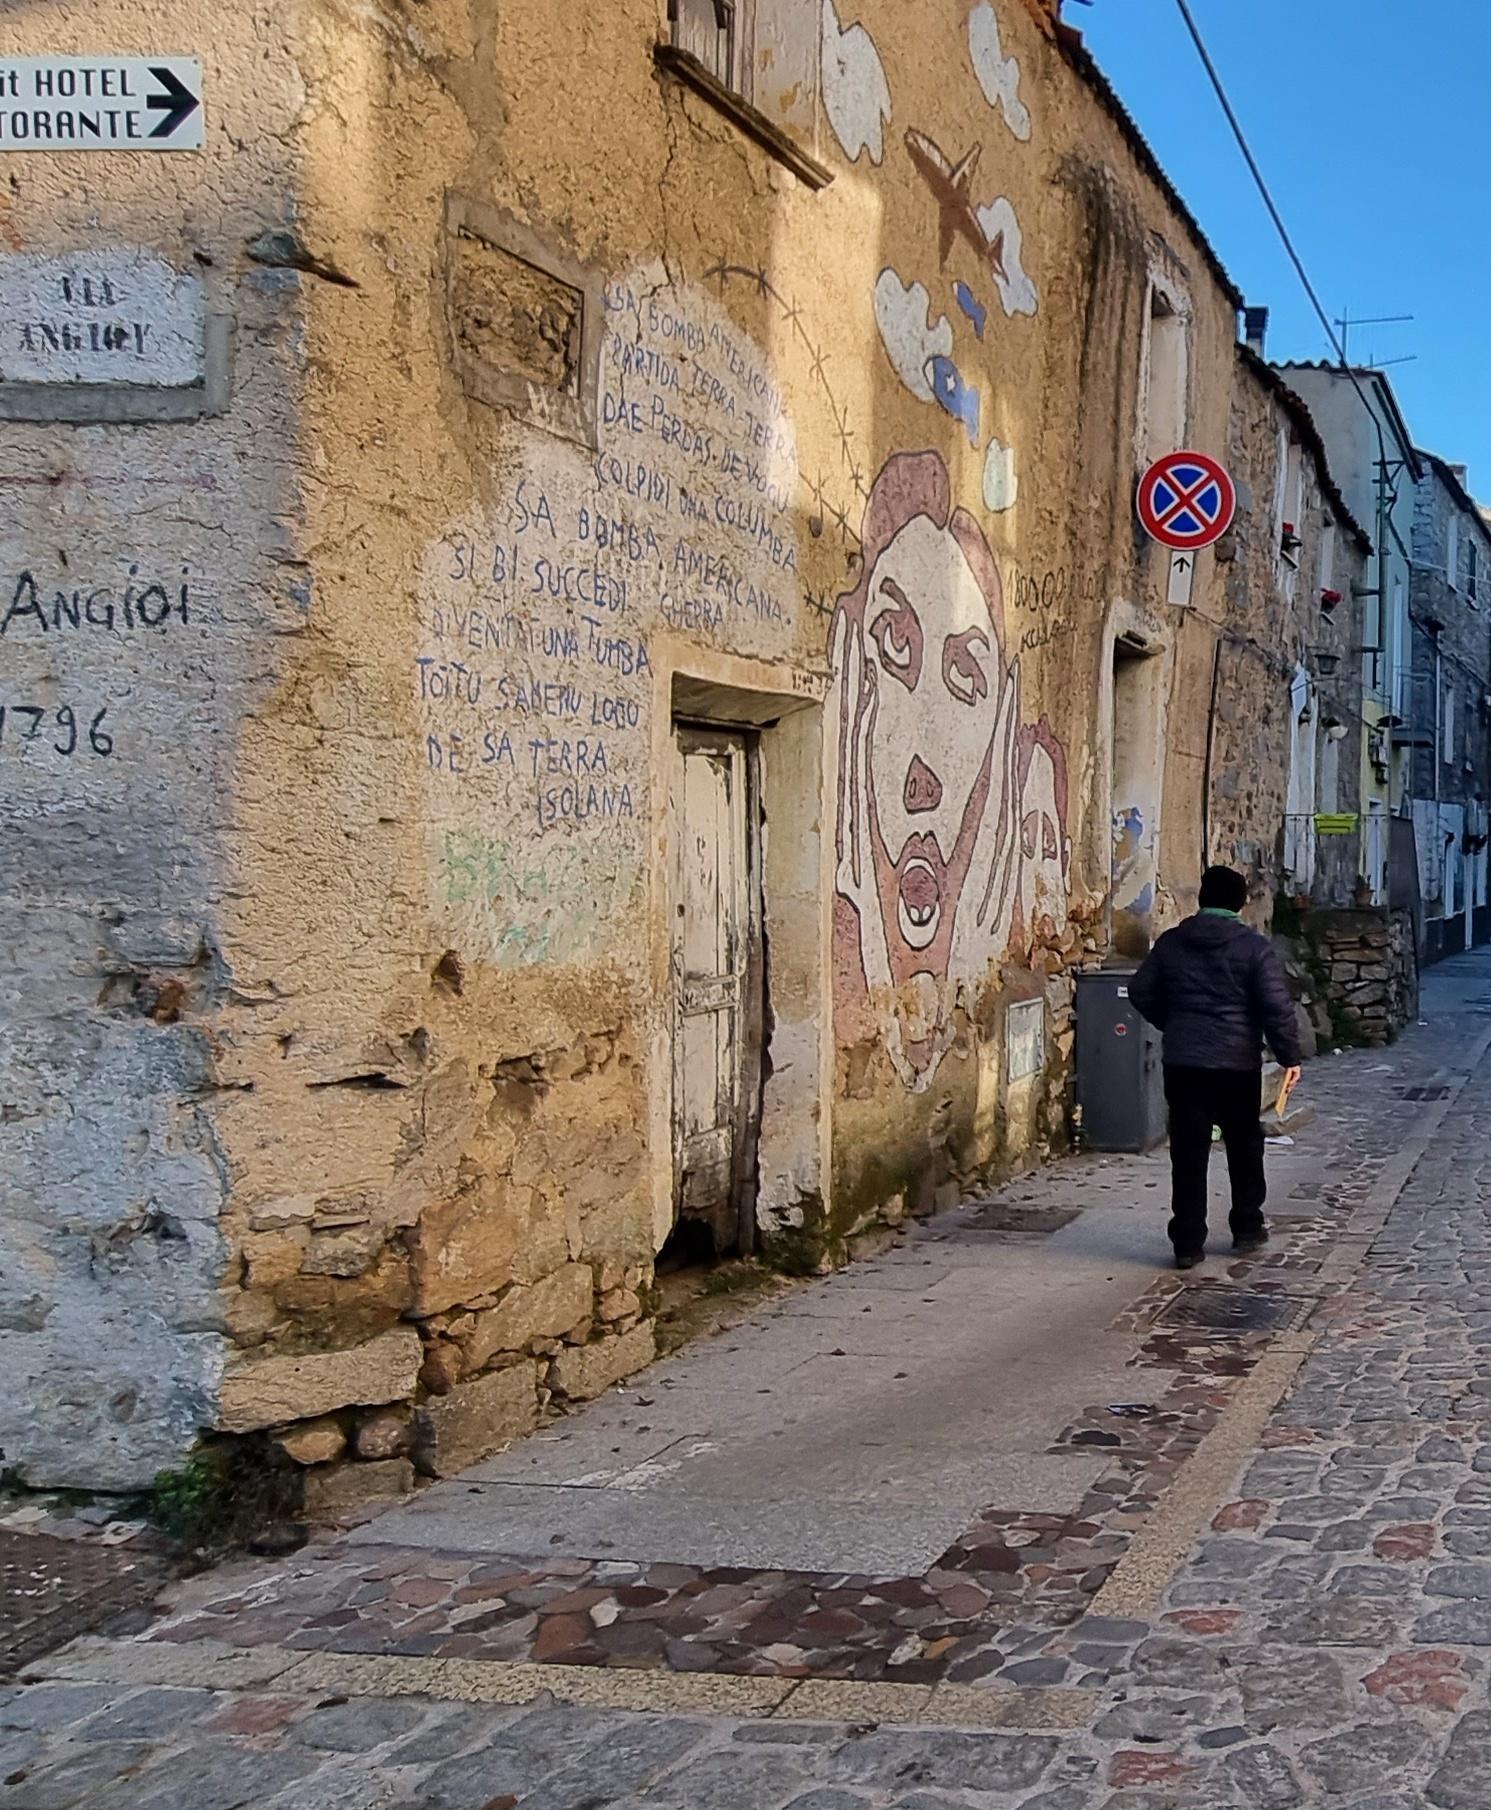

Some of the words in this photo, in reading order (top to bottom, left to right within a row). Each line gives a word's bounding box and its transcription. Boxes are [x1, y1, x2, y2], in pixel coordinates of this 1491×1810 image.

[35, 69, 137, 97] HOTEL
[612, 332, 680, 396] PARTIDA
[603, 392, 643, 433] DAE
[514, 480, 557, 539] SA
[578, 507, 661, 561] BOMBA
[598, 452, 670, 510] COLPIDI
[716, 495, 797, 573] COLUMBA
[450, 543, 475, 583] SI
[492, 543, 518, 583] BI
[532, 559, 626, 615] SUCCEDI
[581, 615, 653, 678] TUMBA
[482, 730, 516, 767] SA
[528, 738, 608, 777] TERRA
